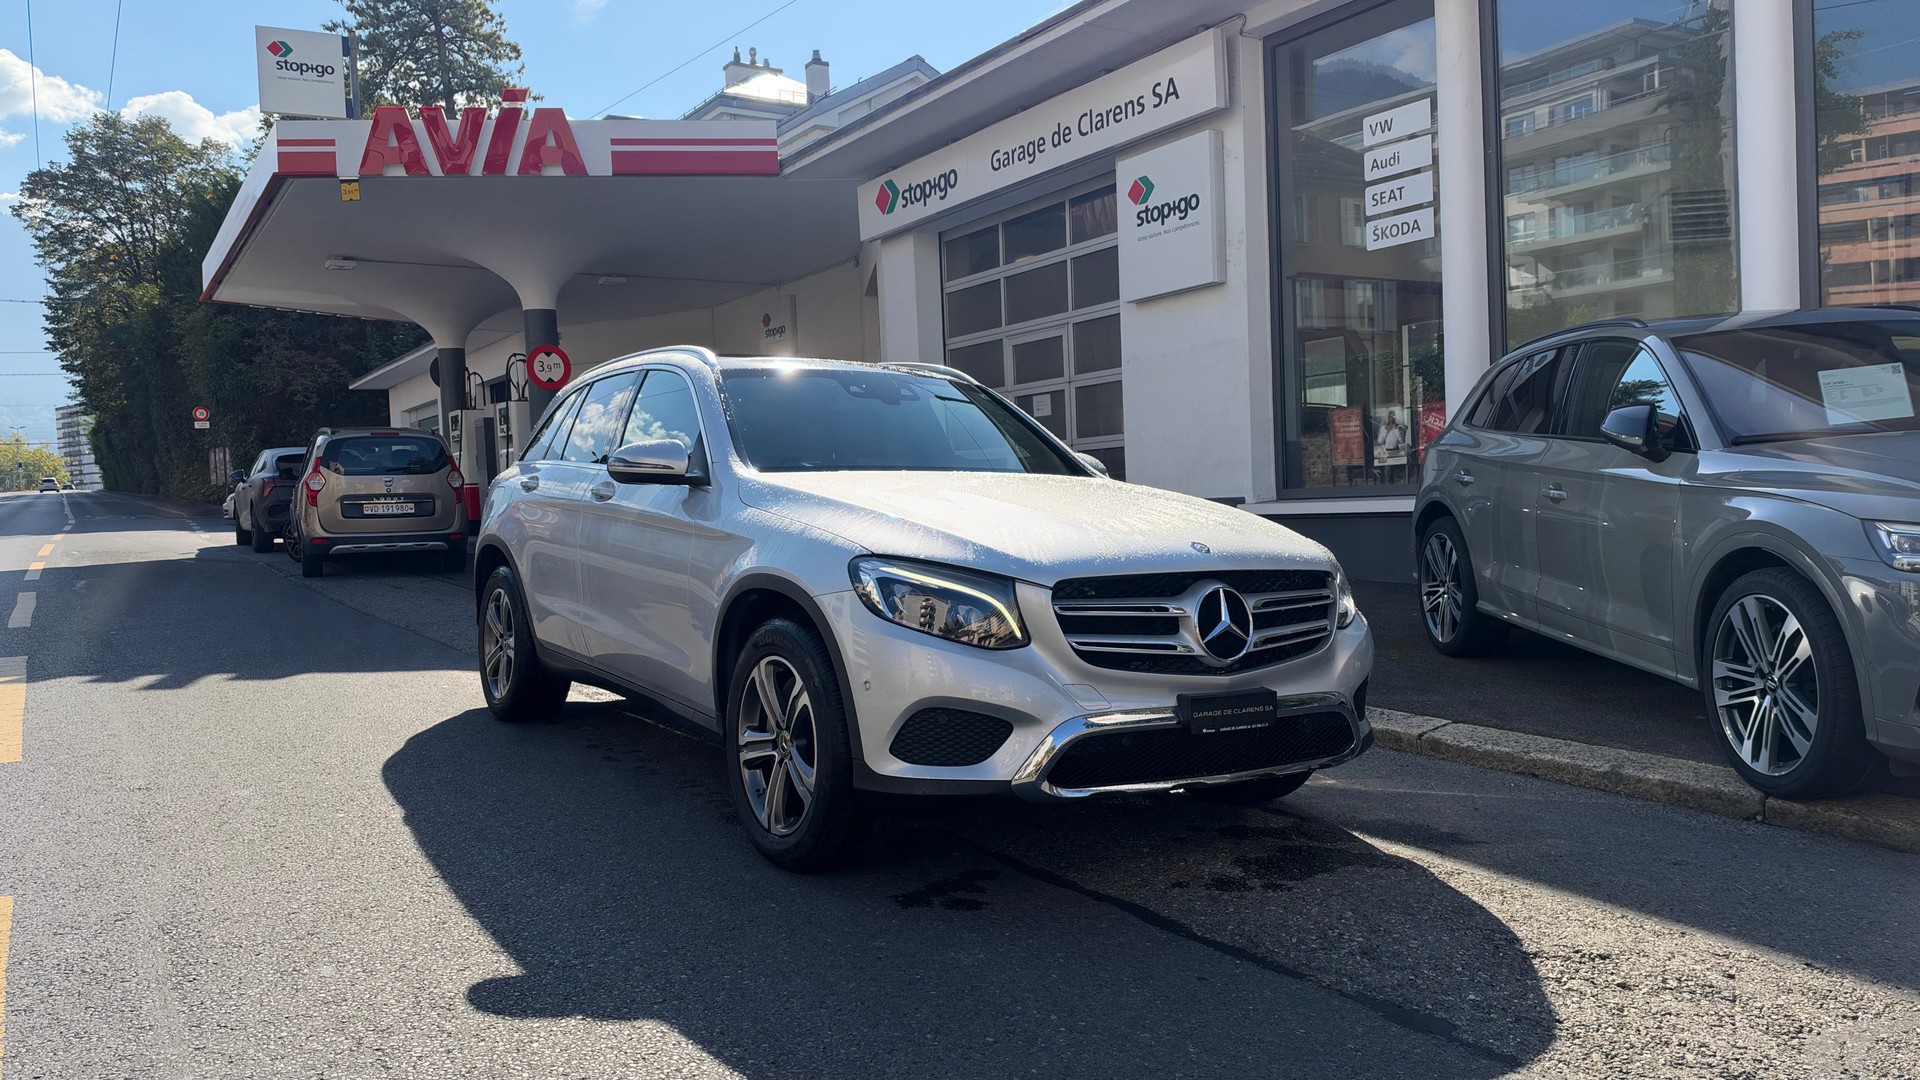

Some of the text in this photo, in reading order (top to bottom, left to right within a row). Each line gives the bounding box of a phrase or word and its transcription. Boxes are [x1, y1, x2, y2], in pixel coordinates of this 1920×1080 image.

[276, 59, 335, 78] stop+go
[990, 77, 1180, 172] Garage de Clarens SA
[1369, 117, 1394, 137] VW
[1370, 151, 1401, 172] Audi
[901, 168, 958, 209] stop+go
[1371, 186, 1406, 207] SEAT
[1136, 193, 1200, 228] stop+go
[1372, 219, 1422, 242] ŠKODA
[1193, 709, 1222, 718] GARAGE
[1233, 706, 1264, 715] CLARENS
